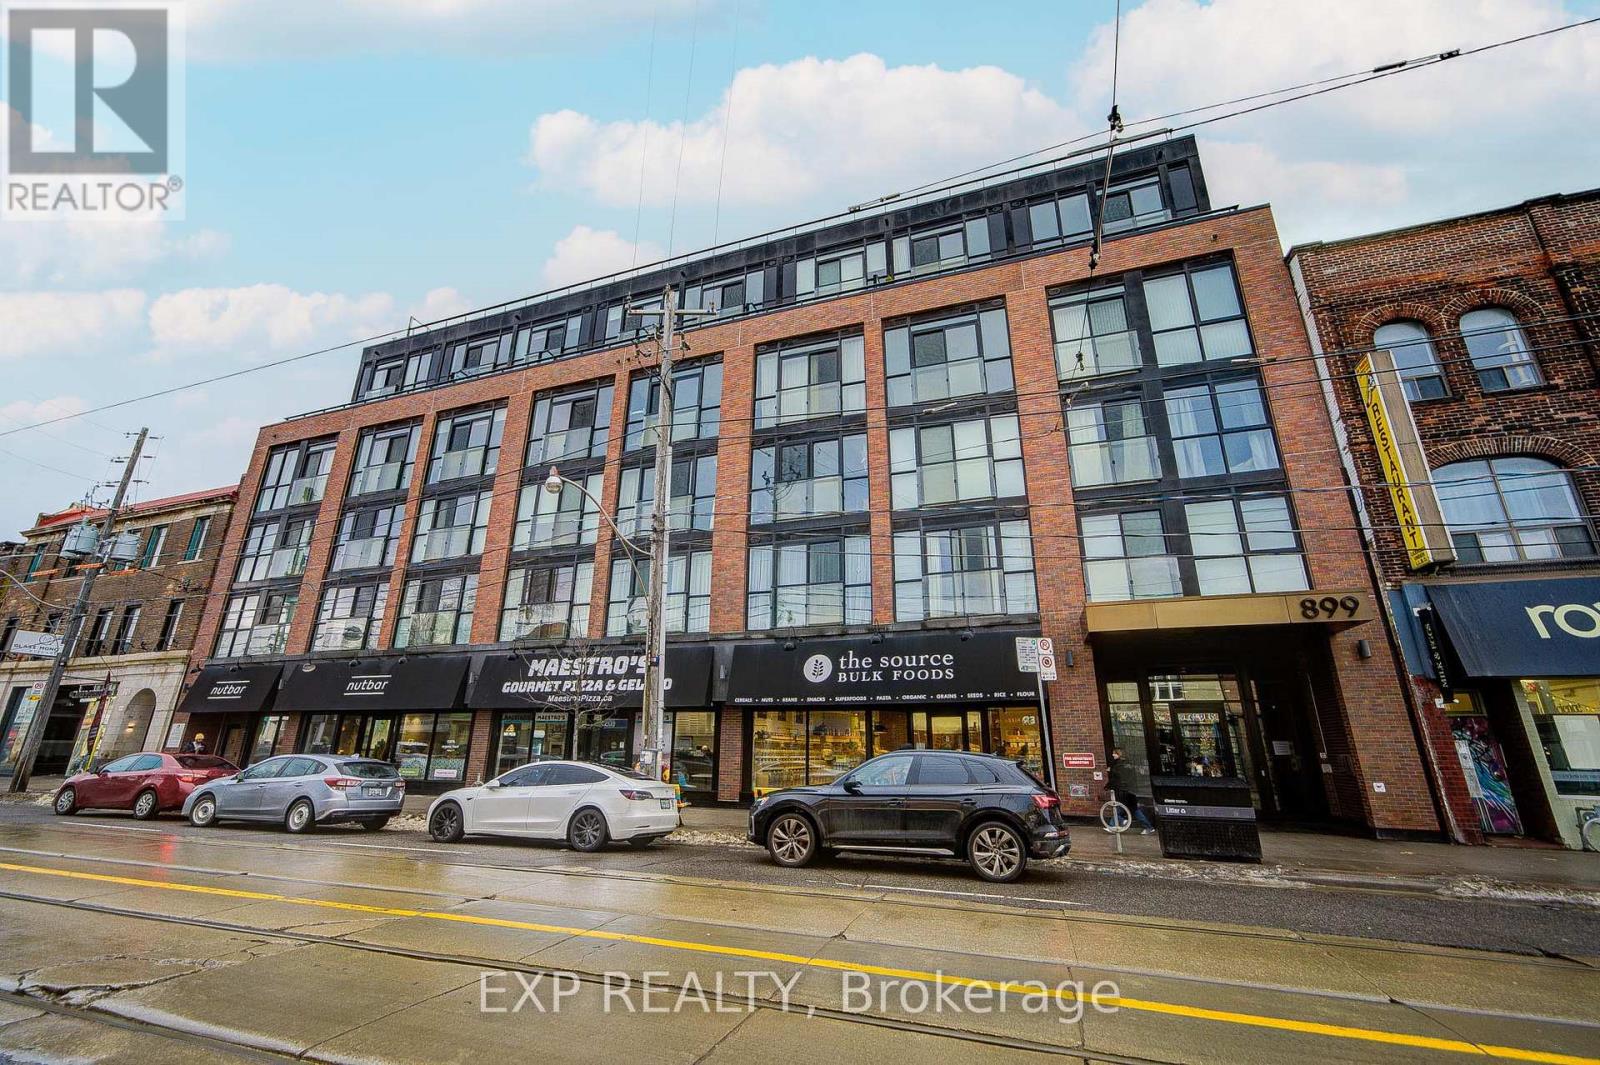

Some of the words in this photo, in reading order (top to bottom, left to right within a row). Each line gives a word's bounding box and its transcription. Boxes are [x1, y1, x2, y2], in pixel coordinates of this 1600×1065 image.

[1371, 402, 1417, 548] RESTAURANT
[1300, 595, 1360, 619] 899
[1524, 602, 1600, 638] ro
[527, 655, 646, 677] MAESTRO'S
[839, 651, 873, 669] the
[880, 653, 954, 668] source
[837, 671, 883, 682] BULK
[892, 668, 954, 681] FOODS
[1436, 661, 1449, 688] MILK
[210, 684, 247, 695] nutbar
[346, 679, 389, 691] nutbar
[501, 680, 561, 693] GOURMET
[604, 679, 616, 691] &
[617, 678, 673, 691] GELO
